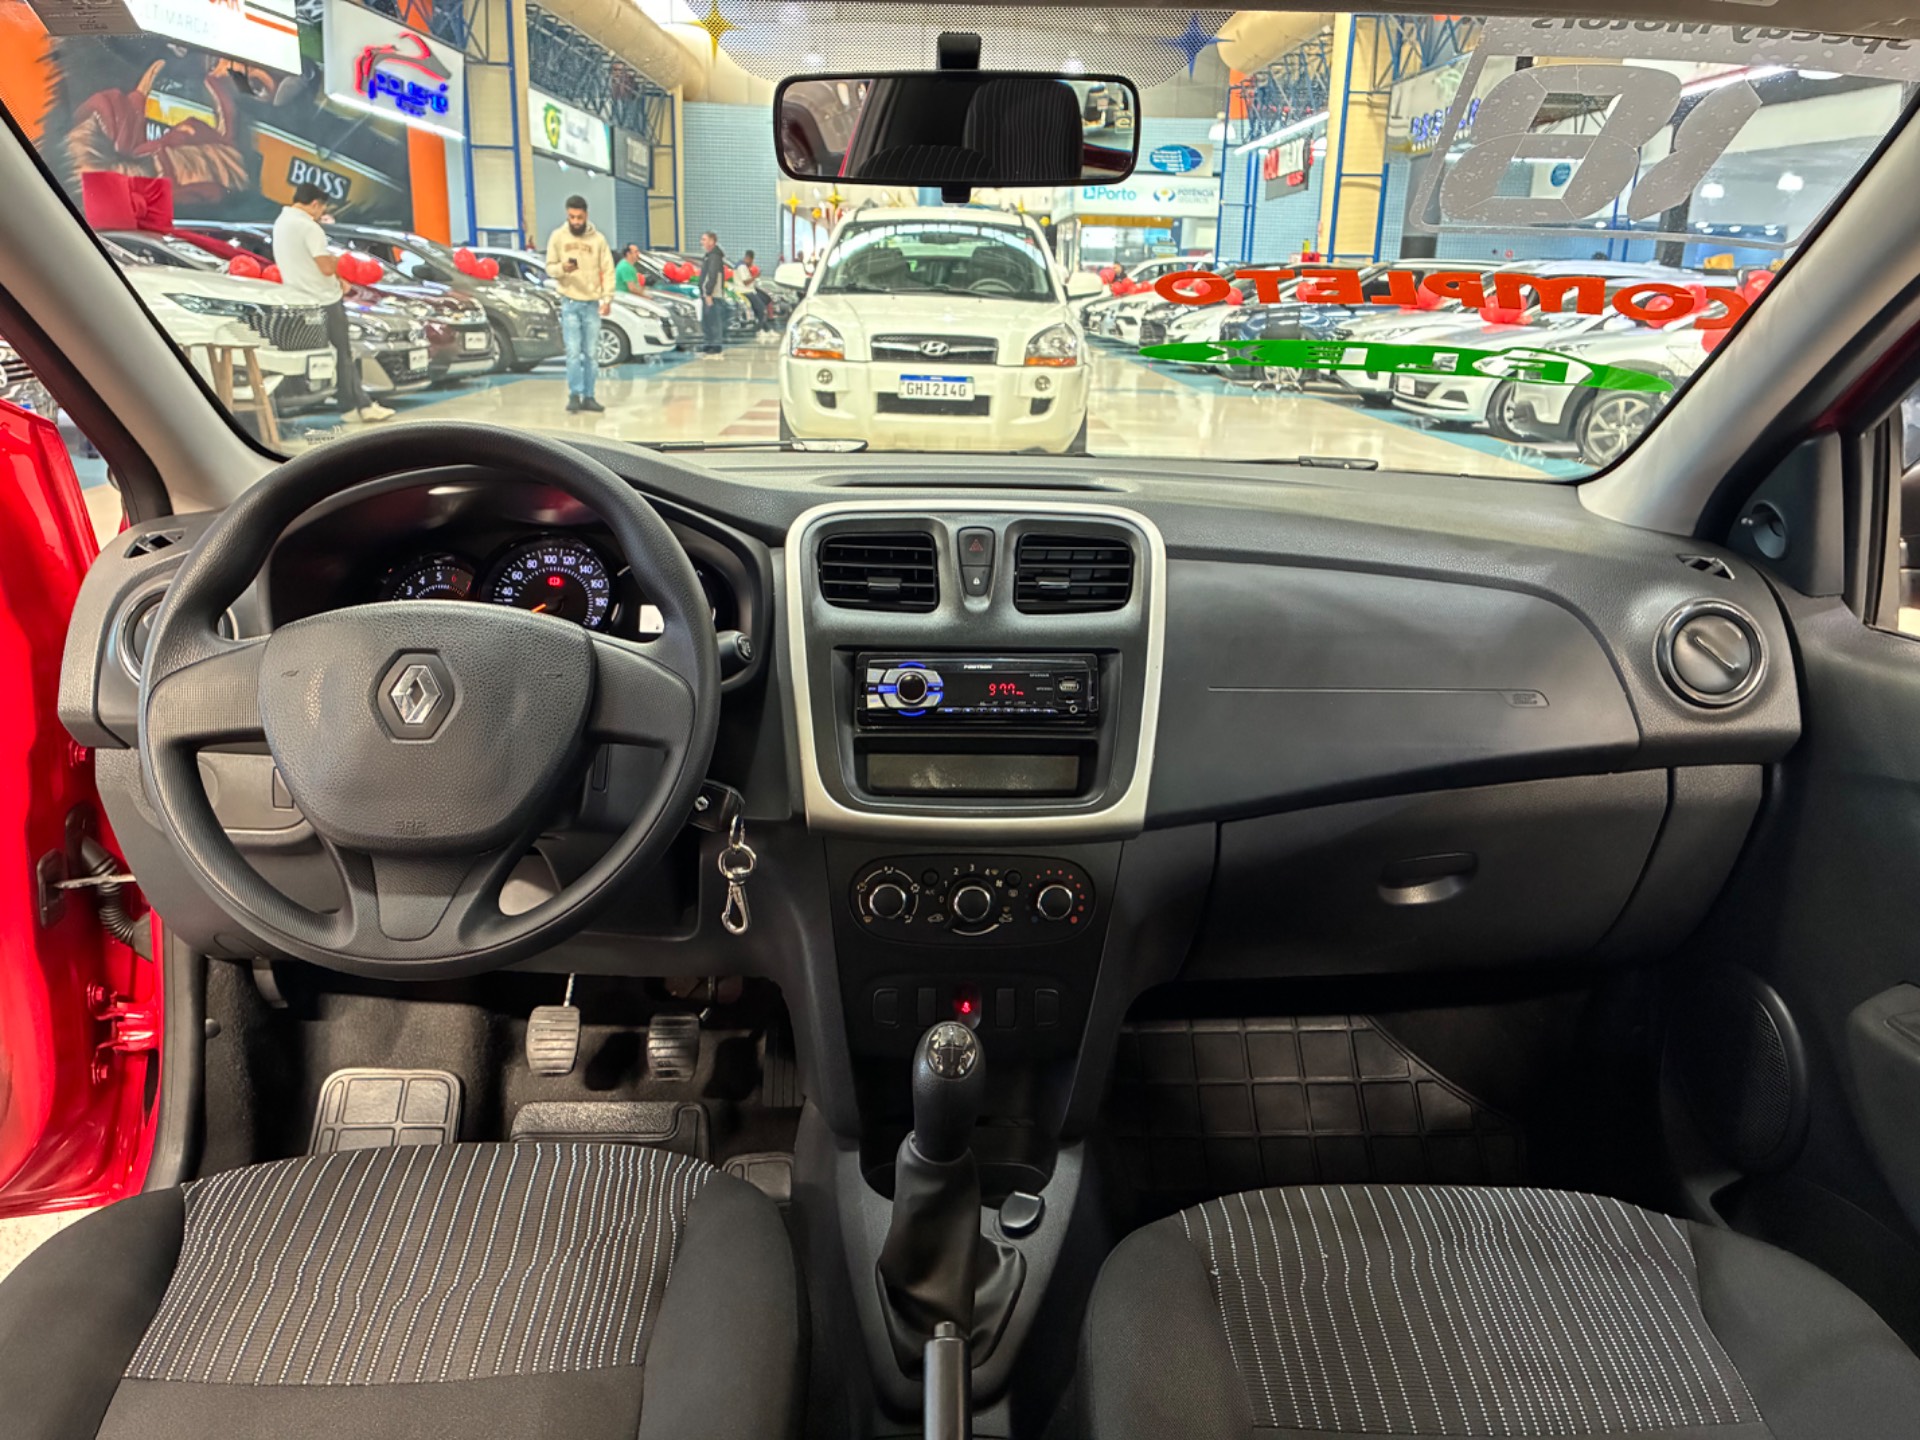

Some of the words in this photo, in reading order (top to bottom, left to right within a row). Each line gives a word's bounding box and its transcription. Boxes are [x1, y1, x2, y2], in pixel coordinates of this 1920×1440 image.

[290, 159, 347, 199] BOSS
[1097, 186, 1137, 201] Porto
[526, 559, 538, 569] 80
[543, 554, 558, 564] 100
[562, 555, 576, 565] 120
[579, 565, 593, 574] 140
[419, 575, 426, 585] 4
[436, 571, 442, 581] 5
[511, 571, 523, 580] 60
[590, 579, 604, 589] 160
[406, 585, 413, 596] 3
[501, 586, 513, 596] 40
[595, 597, 609, 607] 180
